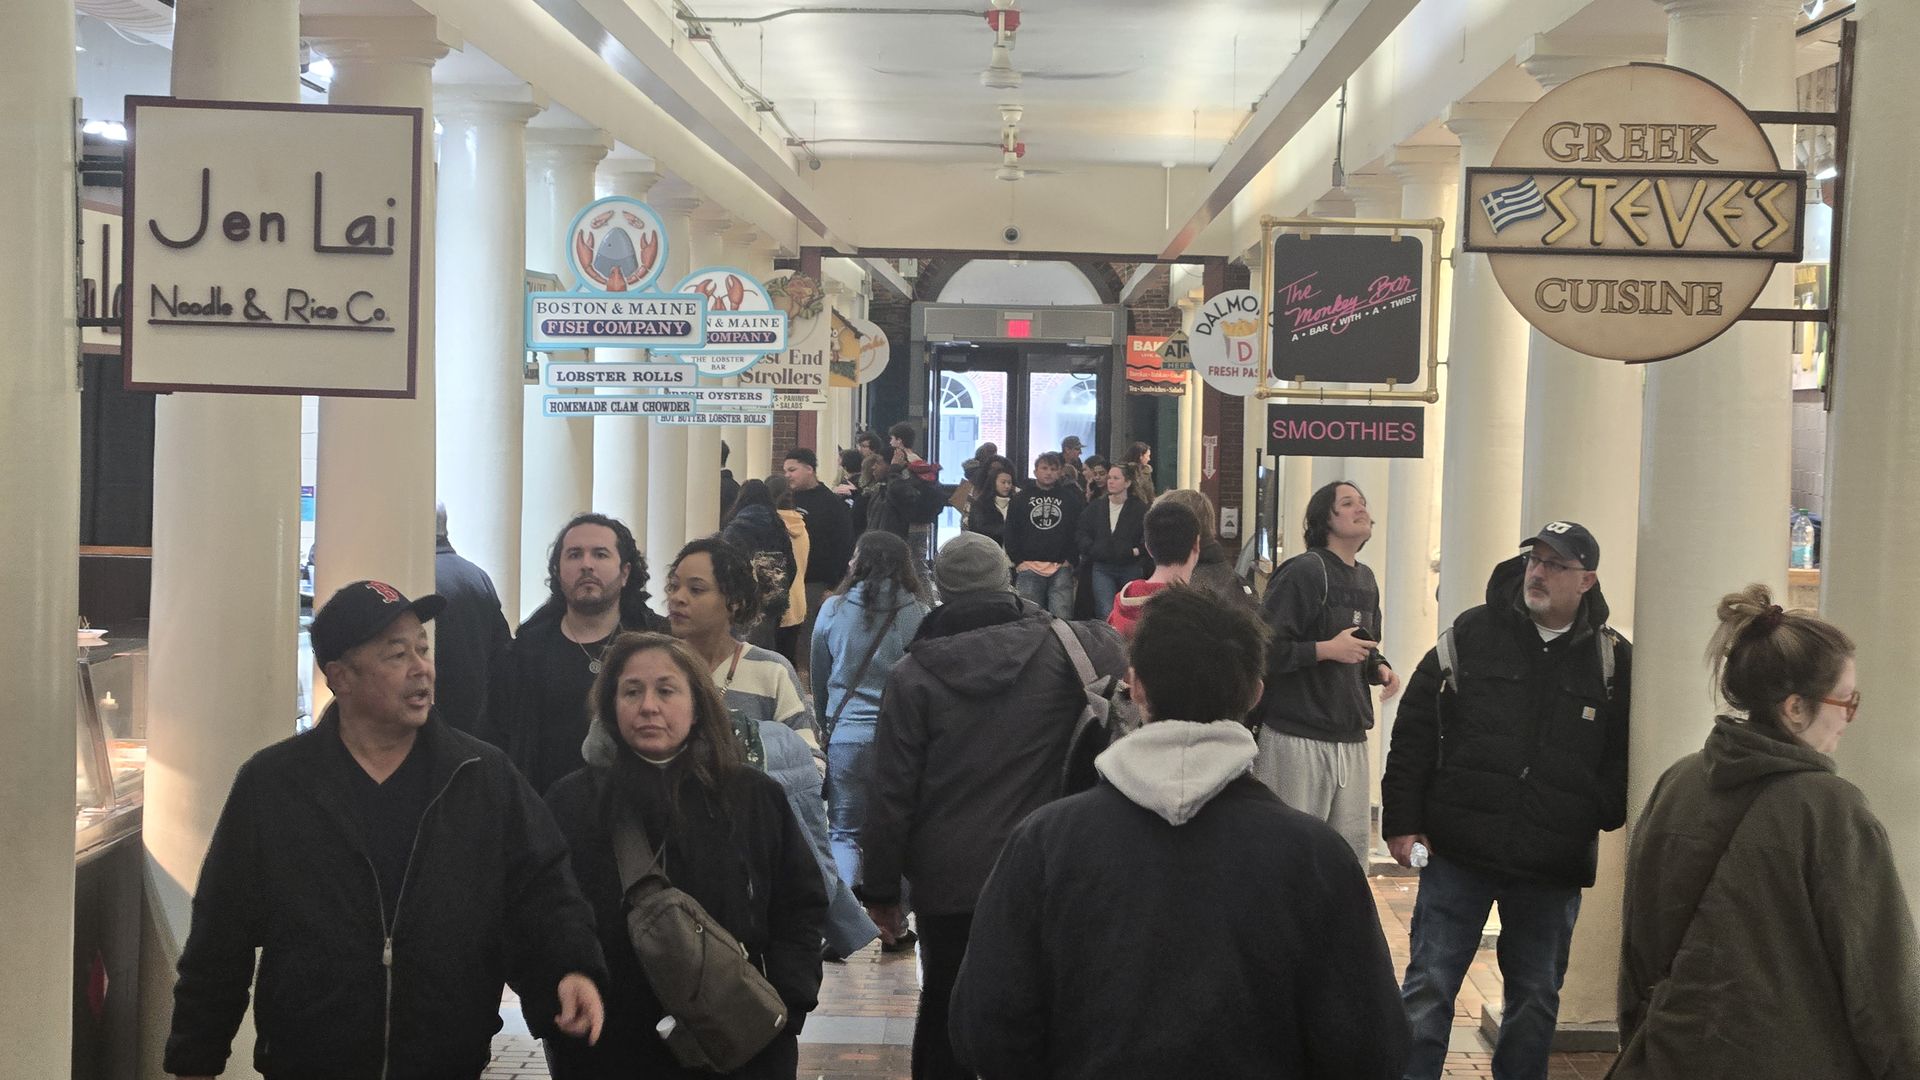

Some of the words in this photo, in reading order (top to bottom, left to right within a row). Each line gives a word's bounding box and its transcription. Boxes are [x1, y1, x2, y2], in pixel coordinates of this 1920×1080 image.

[1543, 121, 1719, 164] GREEK
[148, 168, 286, 249] Jen
[314, 171, 396, 255] Lai
[1541, 177, 1789, 250] STEVE'S
[1278, 272, 1322, 305] The
[1535, 278, 1723, 316] CUISINE
[151, 284, 233, 318] Noodle
[243, 288, 272, 321] &
[285, 288, 338, 323] Rice
[536, 302, 608, 315] BOSTON
[611, 302, 624, 315] &
[629, 303, 697, 315] MAINE
[1284, 294, 1368, 334] Monkey
[1368, 275, 1411, 304] Bar
[714, 318, 724, 328] &
[728, 318, 780, 328] MAINE
[1291, 334, 1299, 342] A
[1309, 323, 1329, 336] BAR
[1339, 312, 1362, 326] WITH
[1372, 307, 1380, 315] A
[1390, 294, 1417, 309] TWIST
[547, 321, 589, 334] FISH
[593, 321, 686, 335] COMPANY
[706, 332, 772, 342] OMPANY
[789, 349, 823, 366] End
[1237, 341, 1253, 362] D
[711, 363, 726, 371] BAR
[1208, 366, 1239, 377] FRESH
[1242, 367, 1273, 379] PASA
[556, 371, 627, 382] LOBSTER
[633, 371, 683, 383] ROLLS
[739, 368, 823, 385] Strollers
[707, 391, 763, 401] OYSTERS
[550, 401, 608, 413] HOMEMADE
[610, 402, 639, 413] CLAM
[642, 402, 691, 413] CHOWDER
[708, 413, 742, 423] LOBSTER
[1272, 420, 1416, 442] SMOOTHIES
